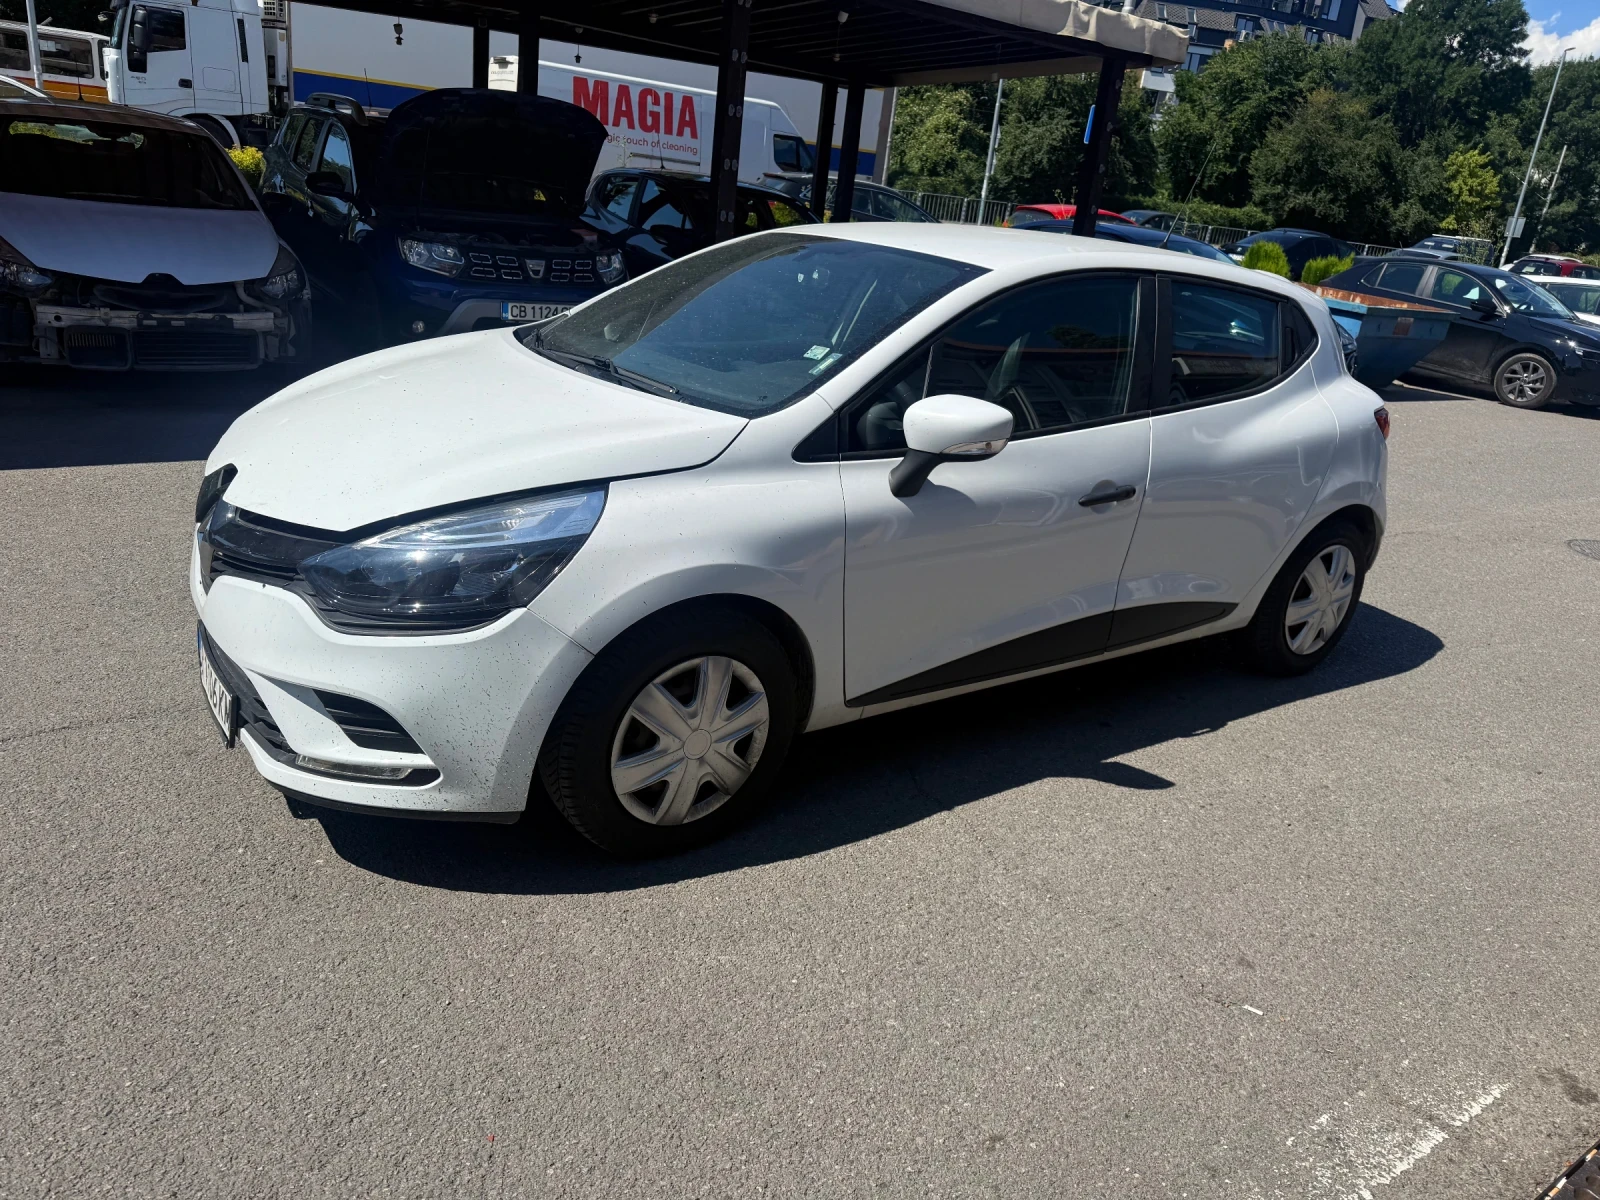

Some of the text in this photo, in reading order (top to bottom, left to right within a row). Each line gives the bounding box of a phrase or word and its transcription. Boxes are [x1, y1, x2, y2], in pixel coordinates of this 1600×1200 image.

[573, 76, 698, 140] MAGIA
[662, 141, 698, 156] cleaning
[510, 305, 527, 318] CB
[531, 306, 558, 319] 1124
